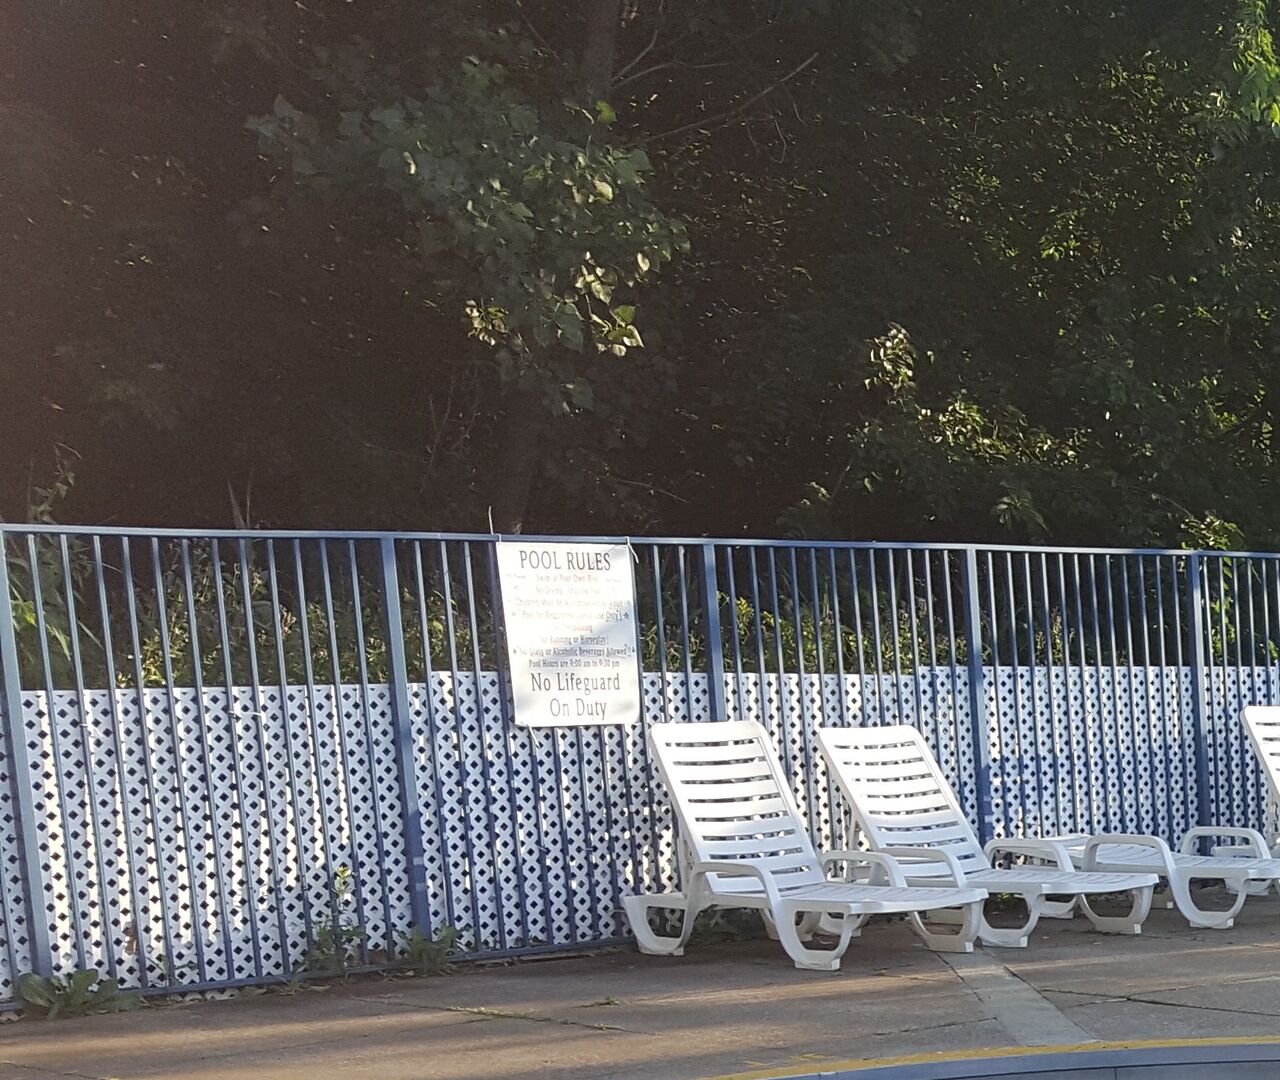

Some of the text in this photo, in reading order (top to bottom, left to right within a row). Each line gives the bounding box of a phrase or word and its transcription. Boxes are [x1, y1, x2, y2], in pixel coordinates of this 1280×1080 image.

[519, 550, 611, 571] POOL RULES
[529, 659, 541, 668] Pool
[531, 672, 620, 695] No Lifeguard
[550, 698, 608, 721] On Duty
